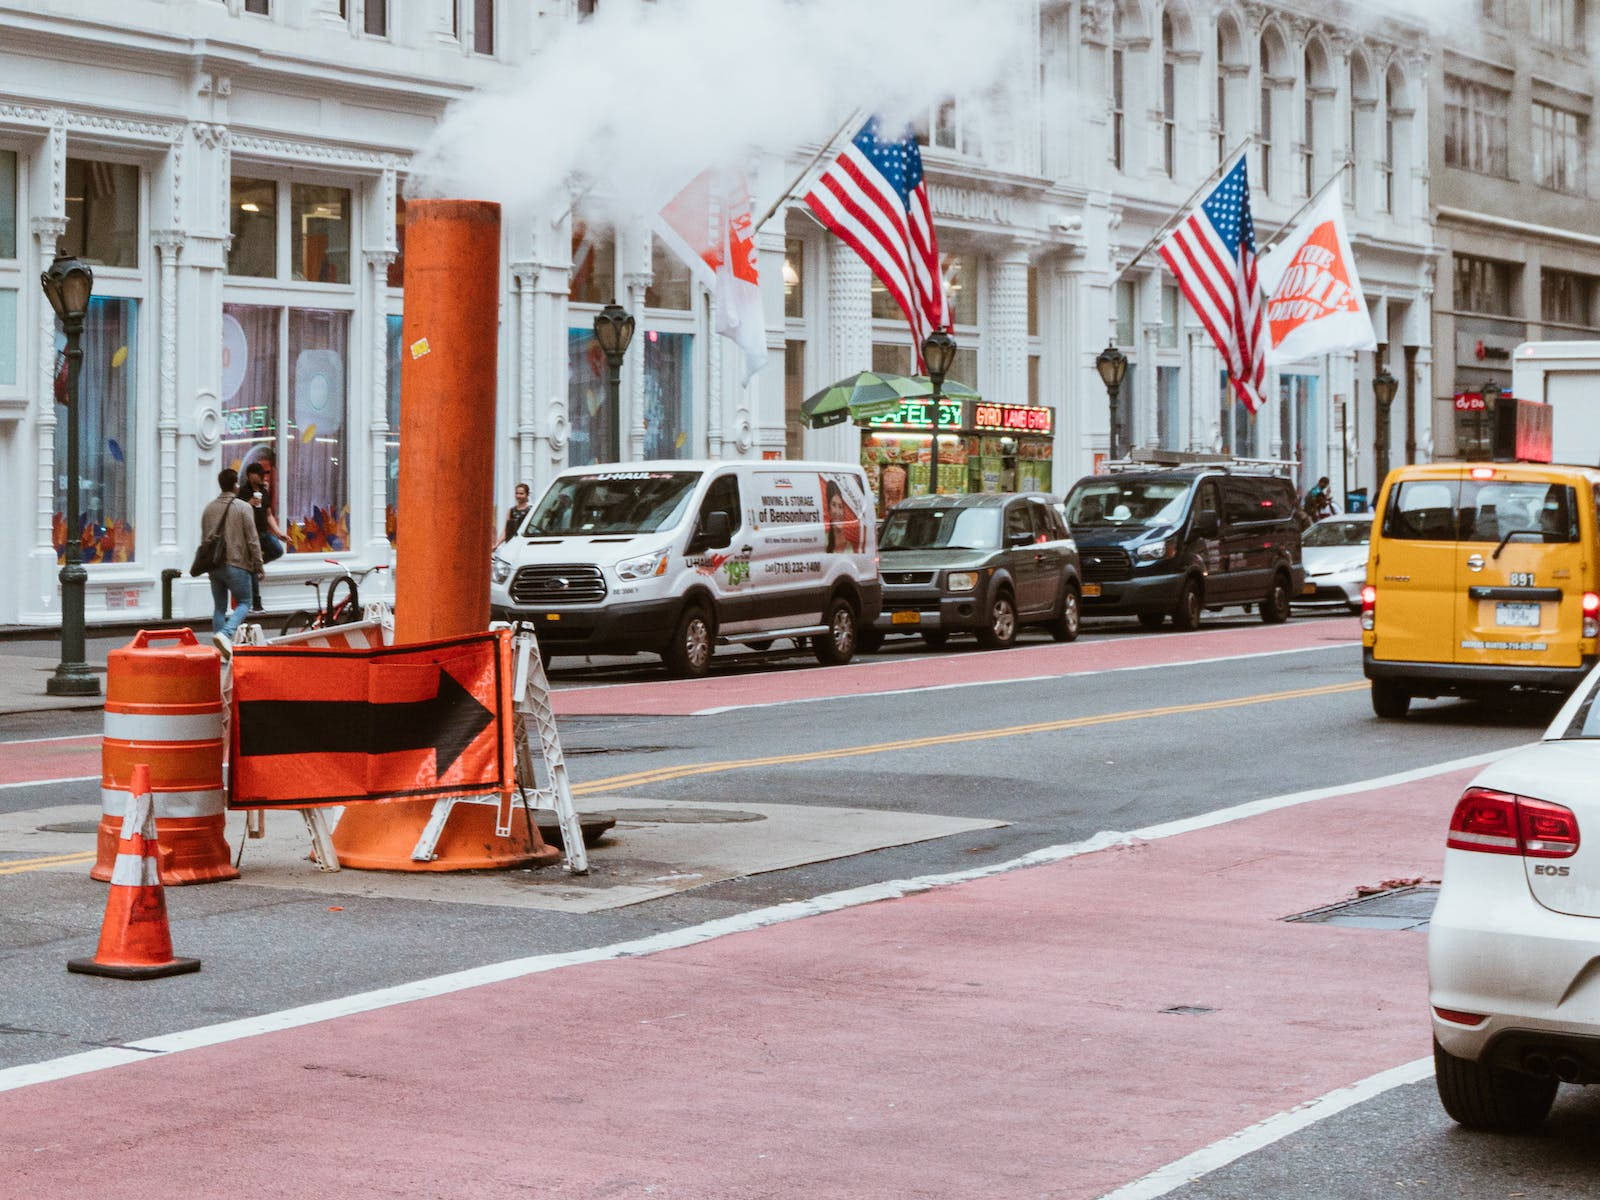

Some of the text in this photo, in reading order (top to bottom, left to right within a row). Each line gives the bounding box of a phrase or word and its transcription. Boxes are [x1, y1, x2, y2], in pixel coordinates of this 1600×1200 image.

[761, 496, 784, 506] MOVING
[790, 496, 815, 506] STORAGE
[759, 508, 768, 523] of
[769, 508, 820, 523] Bensonhurst
[1511, 572, 1535, 587] 891
[1534, 864, 1570, 876] EOS
